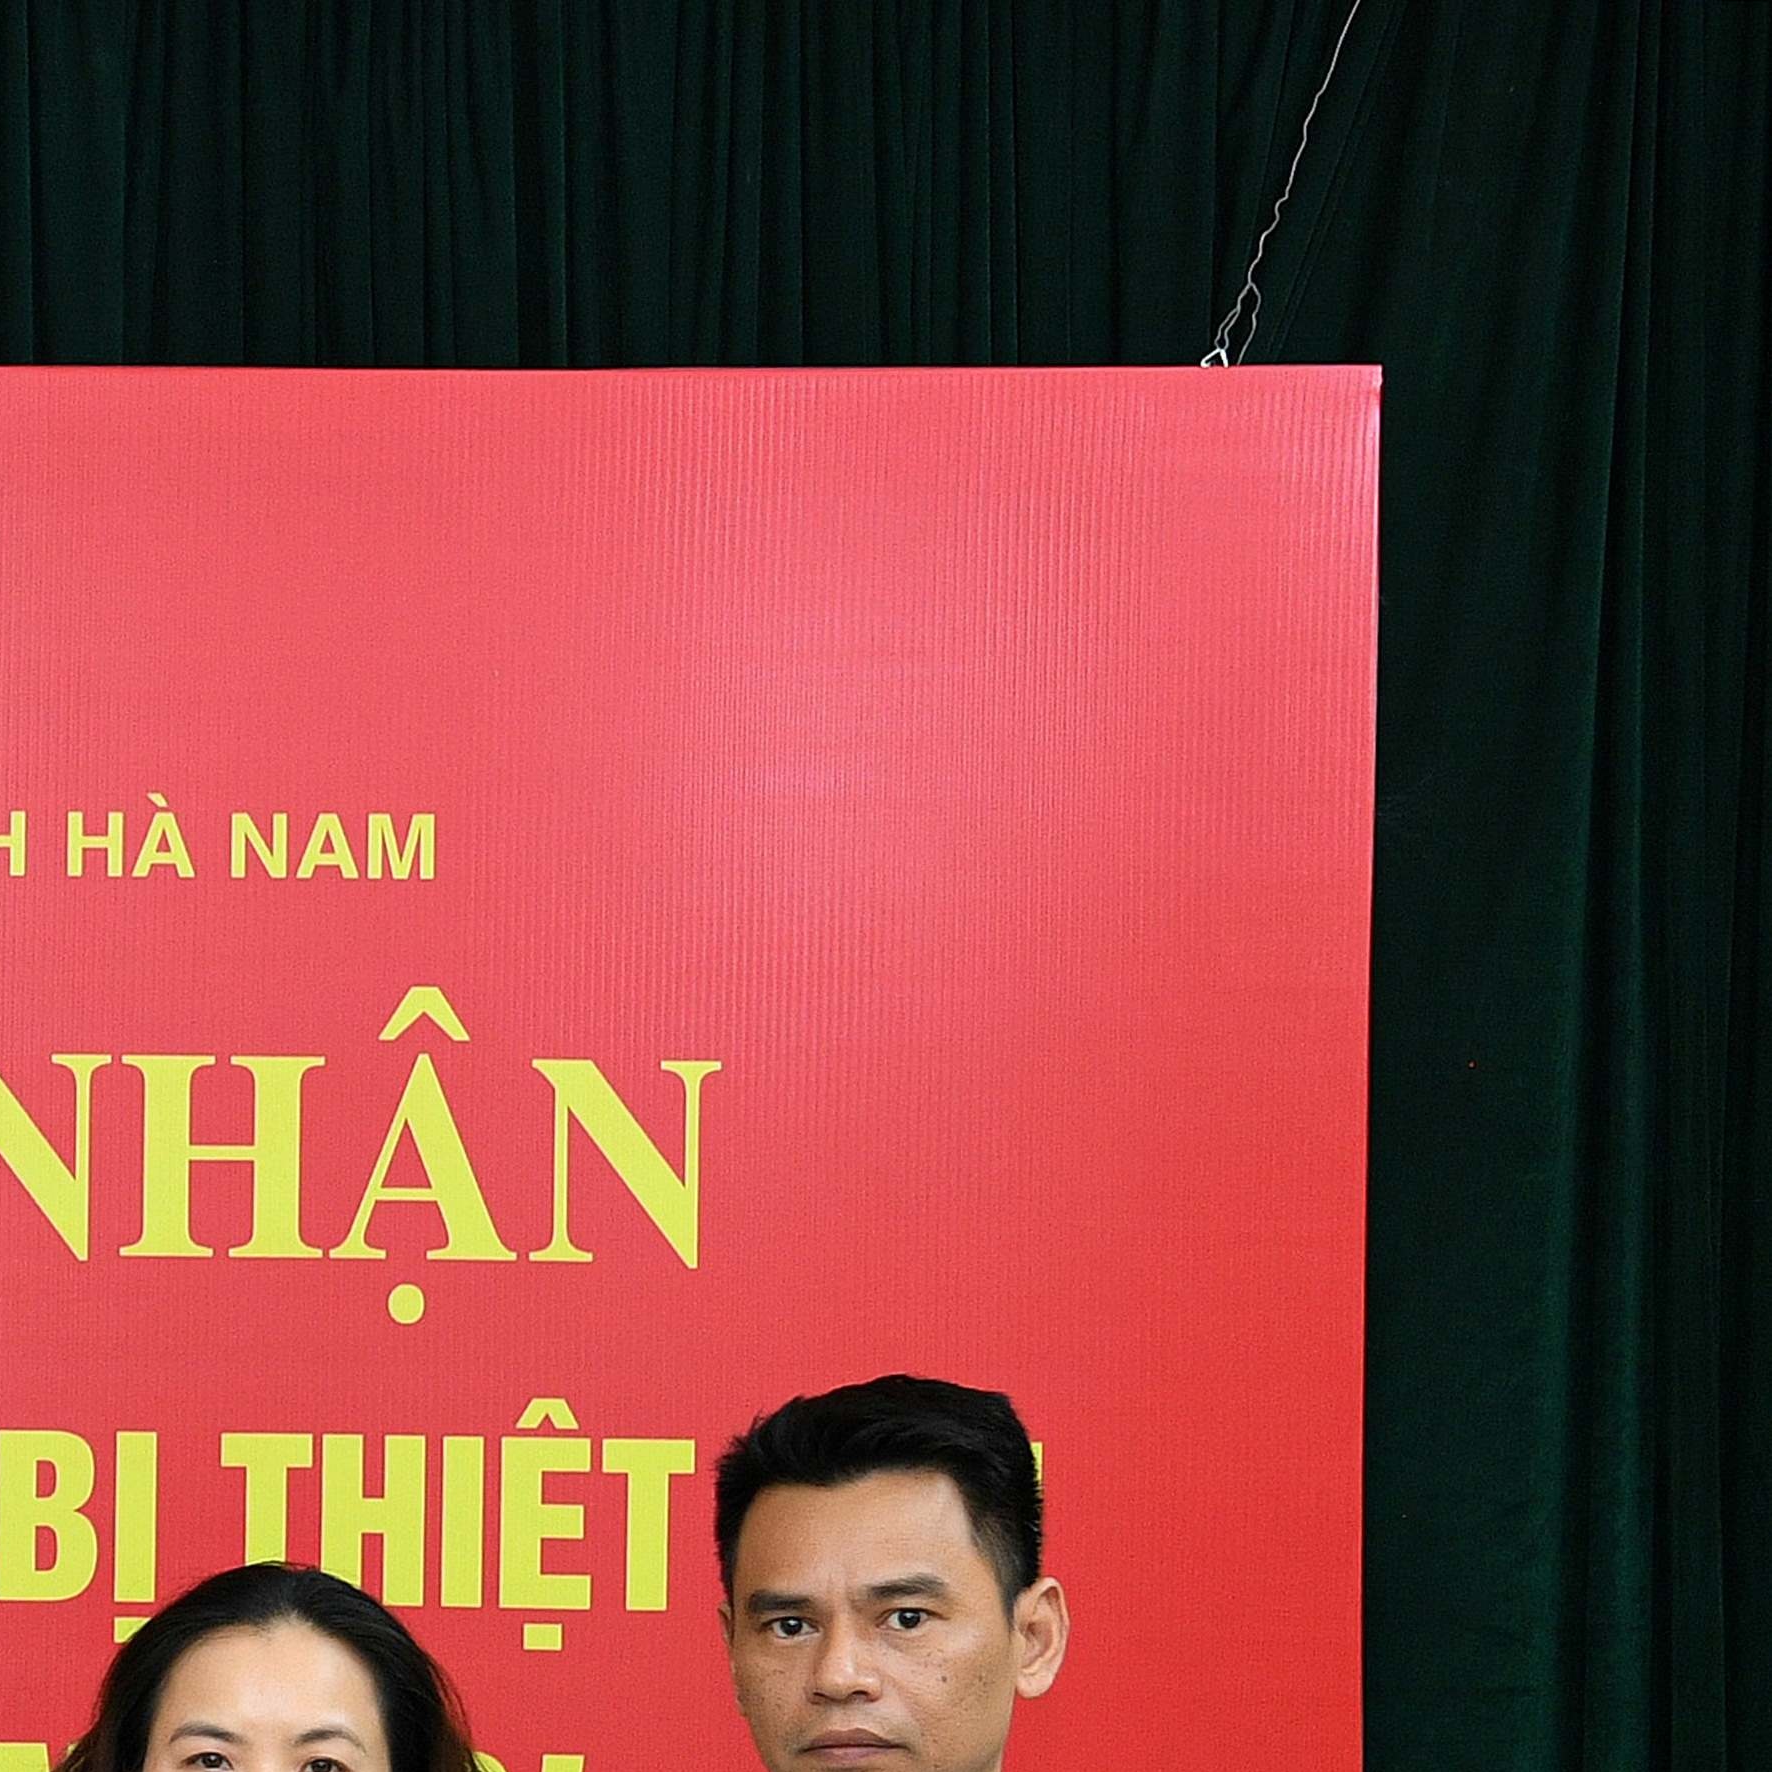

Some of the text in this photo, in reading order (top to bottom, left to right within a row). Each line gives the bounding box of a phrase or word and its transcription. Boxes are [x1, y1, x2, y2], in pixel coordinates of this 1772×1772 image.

[67, 792, 196, 878] HÀ
[231, 812, 436, 880] NAM
[221, 1398, 696, 1651] THIỆT
